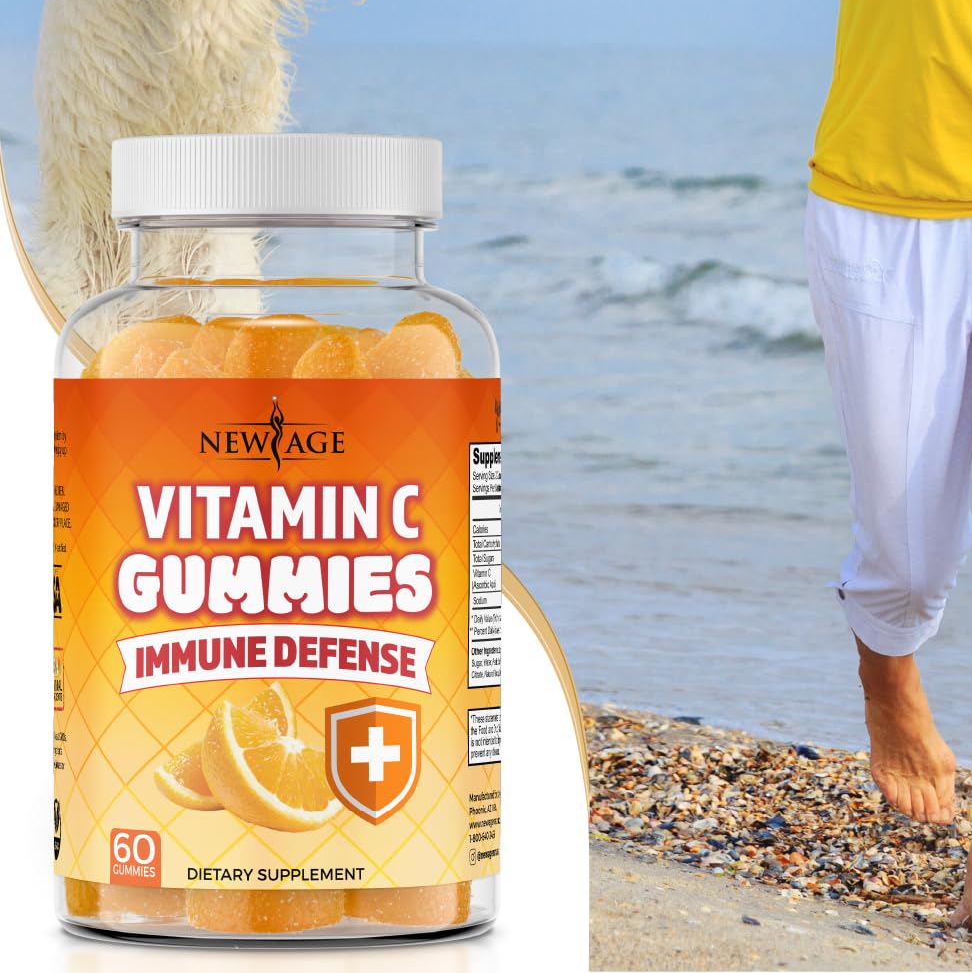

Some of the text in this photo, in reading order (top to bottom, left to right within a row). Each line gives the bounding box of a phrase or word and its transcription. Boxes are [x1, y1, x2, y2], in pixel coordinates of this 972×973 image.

[200, 430, 345, 454] NEW AGE
[137, 484, 420, 539] VITAMIN C
[118, 553, 433, 615] GUMMIES
[135, 635, 417, 679] IMMUNE DEFENSE
[113, 831, 156, 865] 60
[113, 863, 156, 878] GUMMIES
[187, 866, 366, 882] DIETARY SUPPLEMENT
